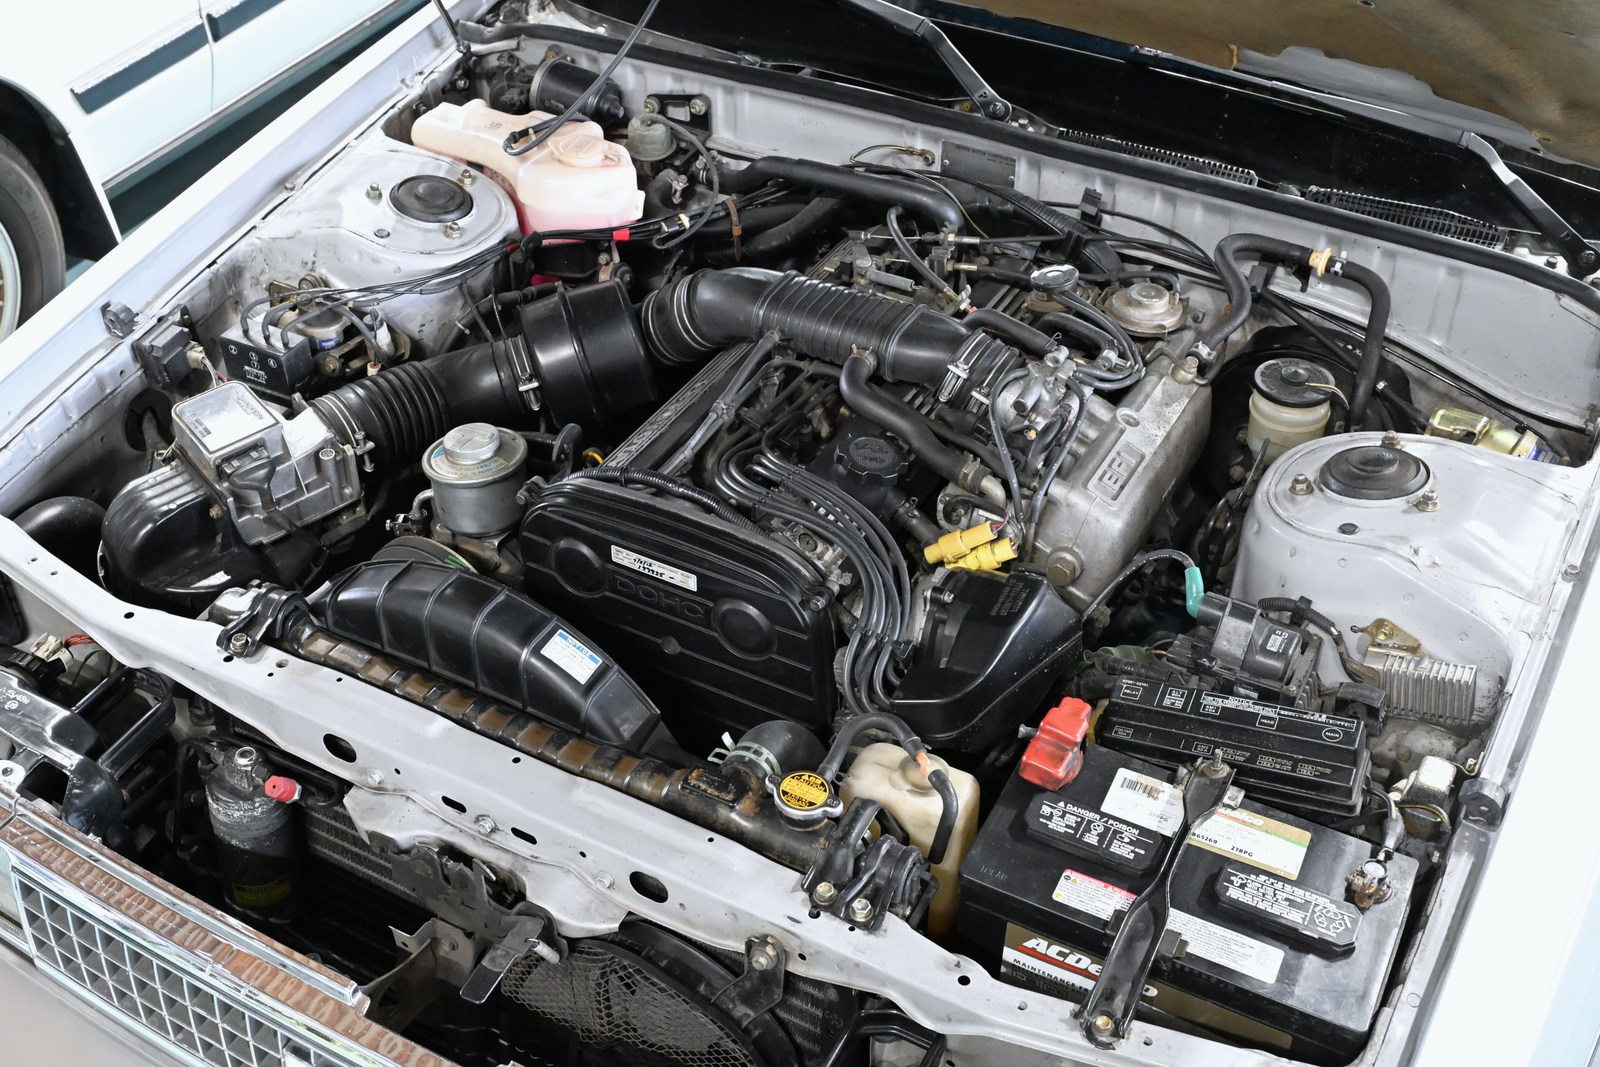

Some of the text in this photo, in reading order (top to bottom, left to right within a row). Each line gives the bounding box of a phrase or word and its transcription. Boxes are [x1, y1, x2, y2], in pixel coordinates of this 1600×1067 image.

[955, 144, 970, 152] TOYOTA
[972, 147, 986, 156] MOTOR
[1098, 451, 1137, 493] EFI
[614, 575, 704, 618] DOHC
[566, 636, 591, 659] NOTICE
[1228, 696, 1252, 706] NOTICE
[794, 776, 825, 791] CAUTION
[1066, 803, 1101, 822] DANGER
[1107, 820, 1139, 836] POISON
[1230, 846, 1253, 857] 27RPG
[1013, 958, 1077, 989] MAINTENANCE
